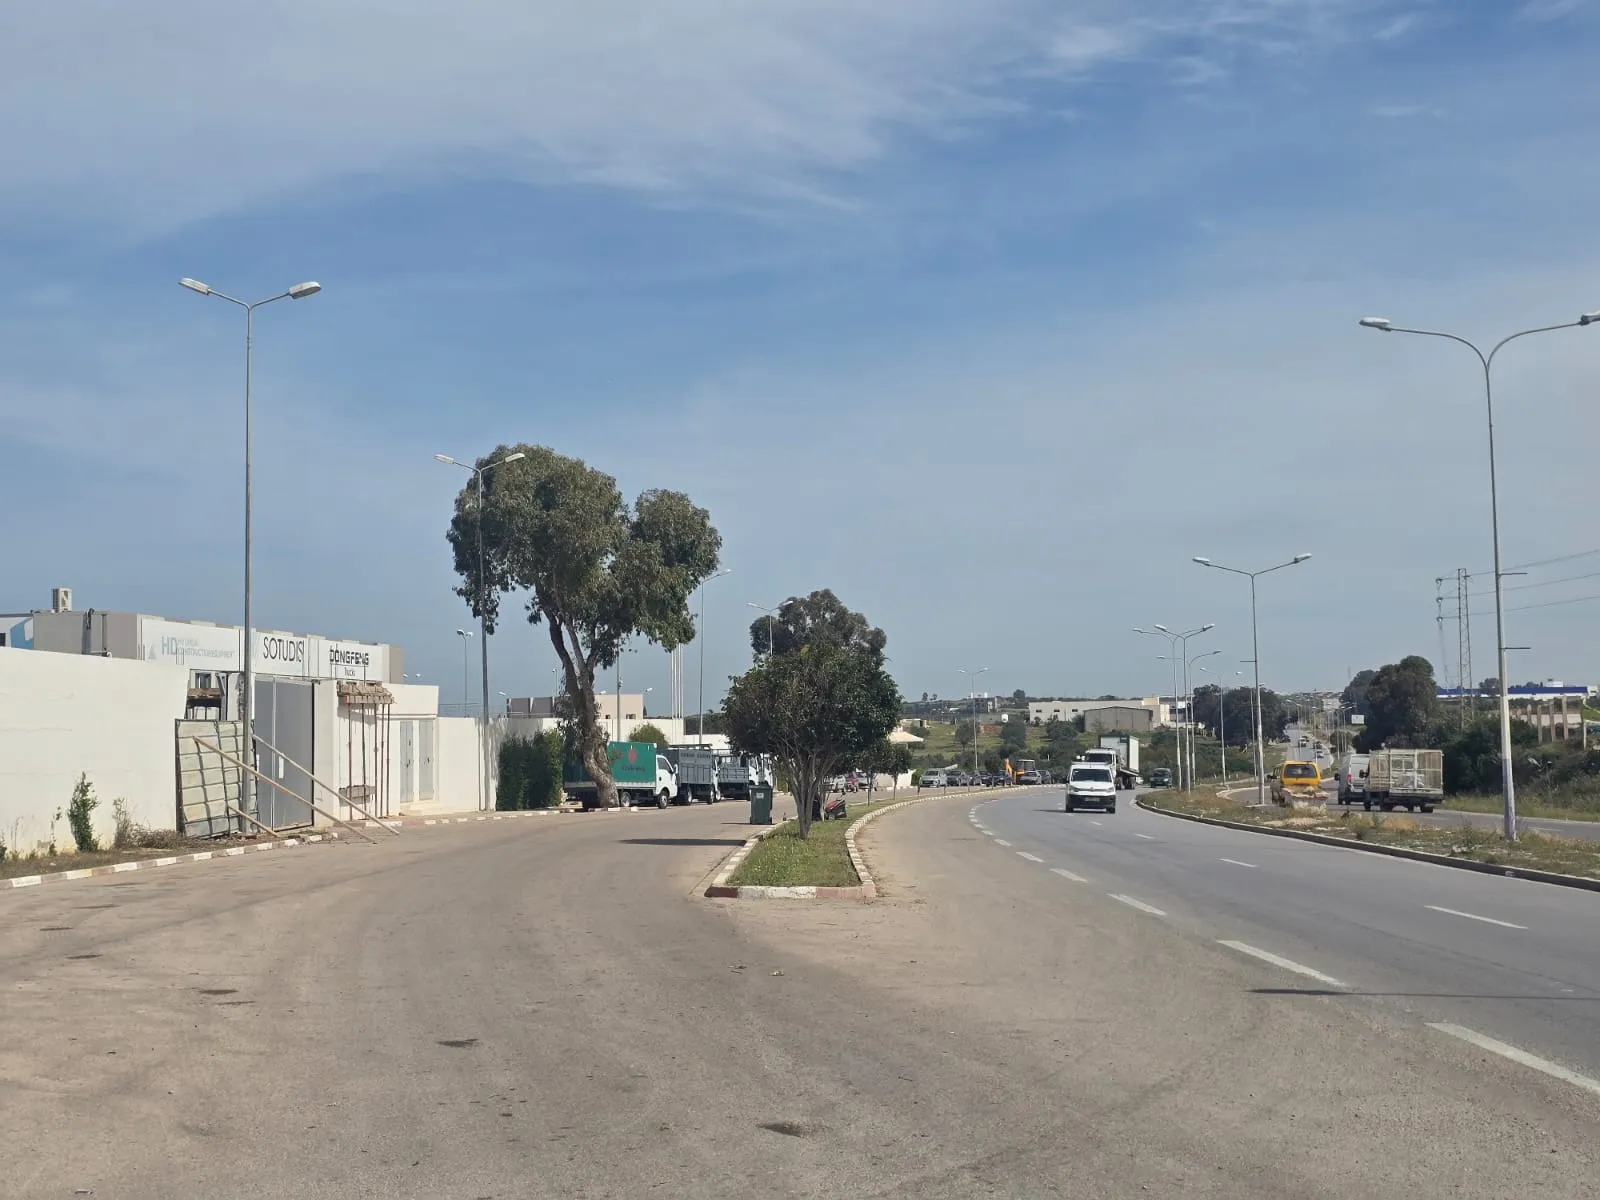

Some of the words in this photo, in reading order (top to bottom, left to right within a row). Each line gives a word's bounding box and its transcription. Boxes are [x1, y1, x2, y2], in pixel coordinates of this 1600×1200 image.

[161, 635, 178, 656] HD
[263, 636, 304, 663] SOTUDIS
[329, 648, 369, 666] DONGFENG
